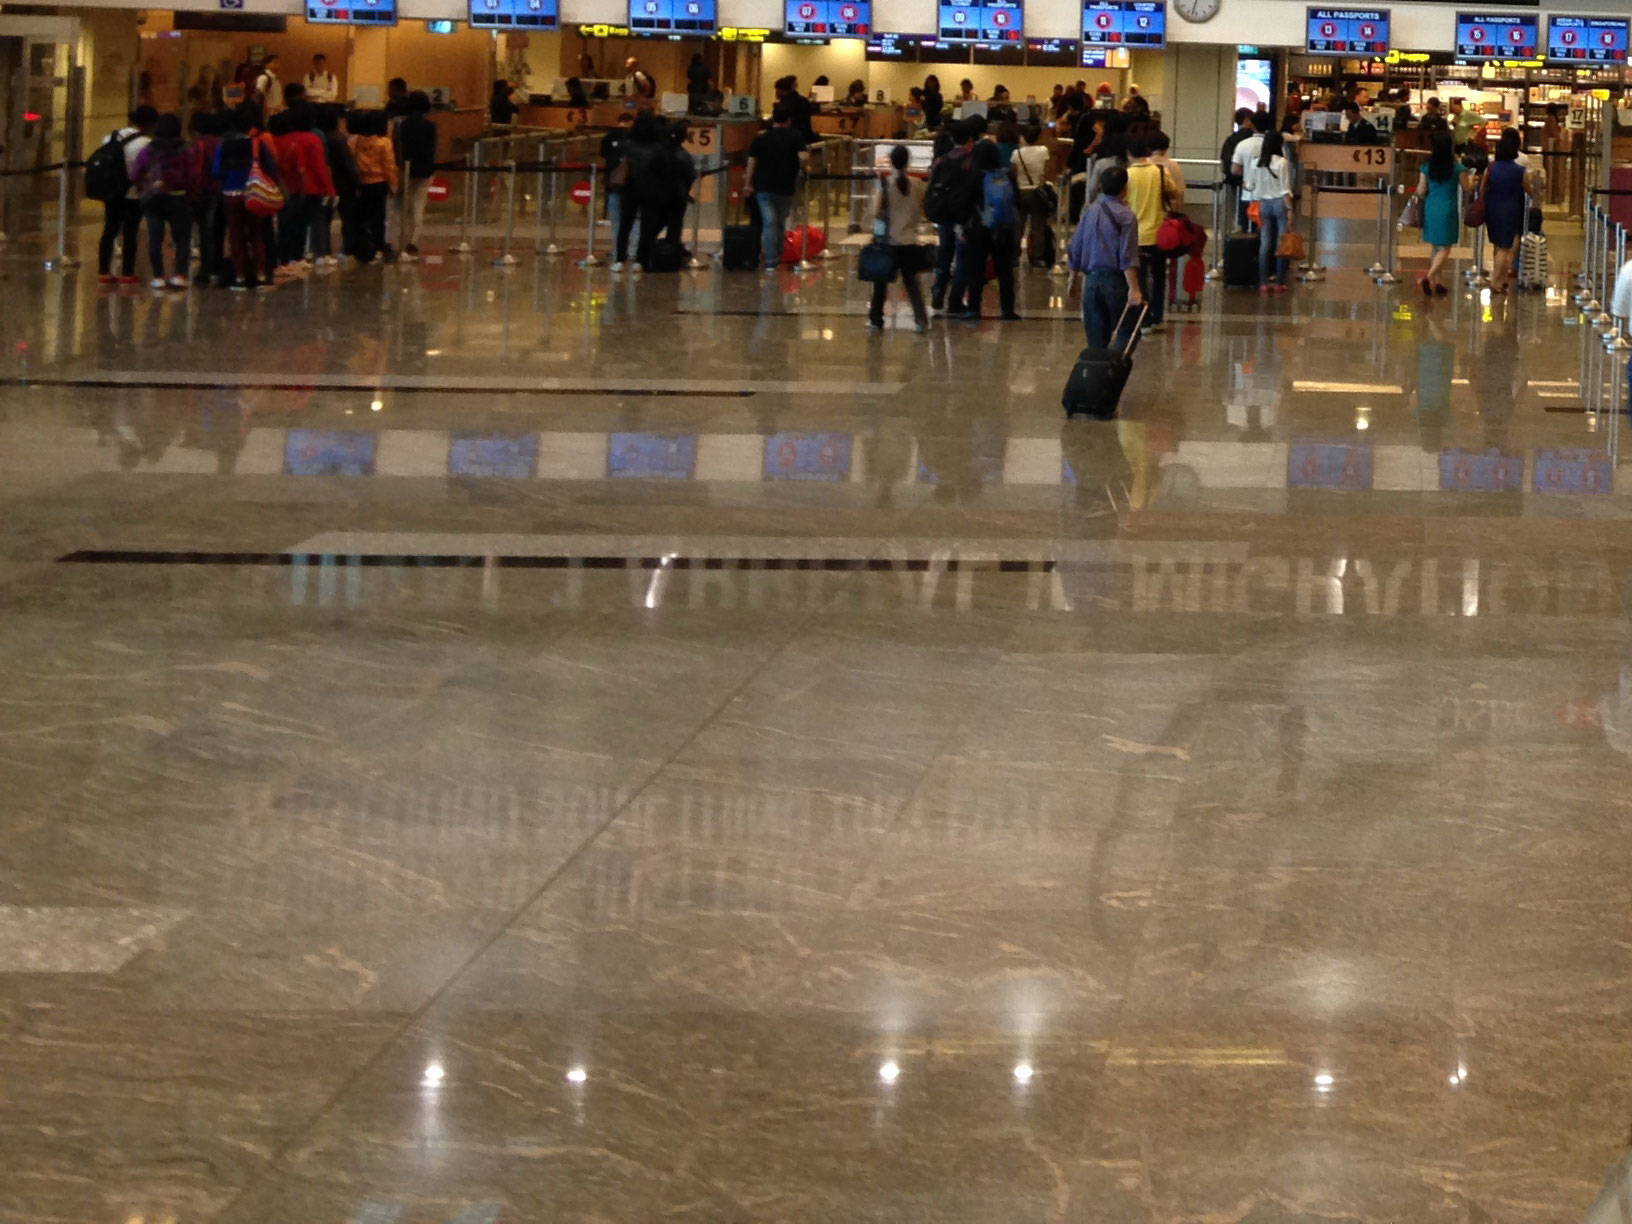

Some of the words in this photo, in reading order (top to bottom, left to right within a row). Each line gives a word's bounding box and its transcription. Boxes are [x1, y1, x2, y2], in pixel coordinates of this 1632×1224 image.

[1334, 11, 1380, 20] PASSPORTS
[1374, 115, 1389, 127] 14
[1571, 109, 1585, 121] 17
[698, 130, 711, 147] 5
[1364, 148, 1387, 165] 13
